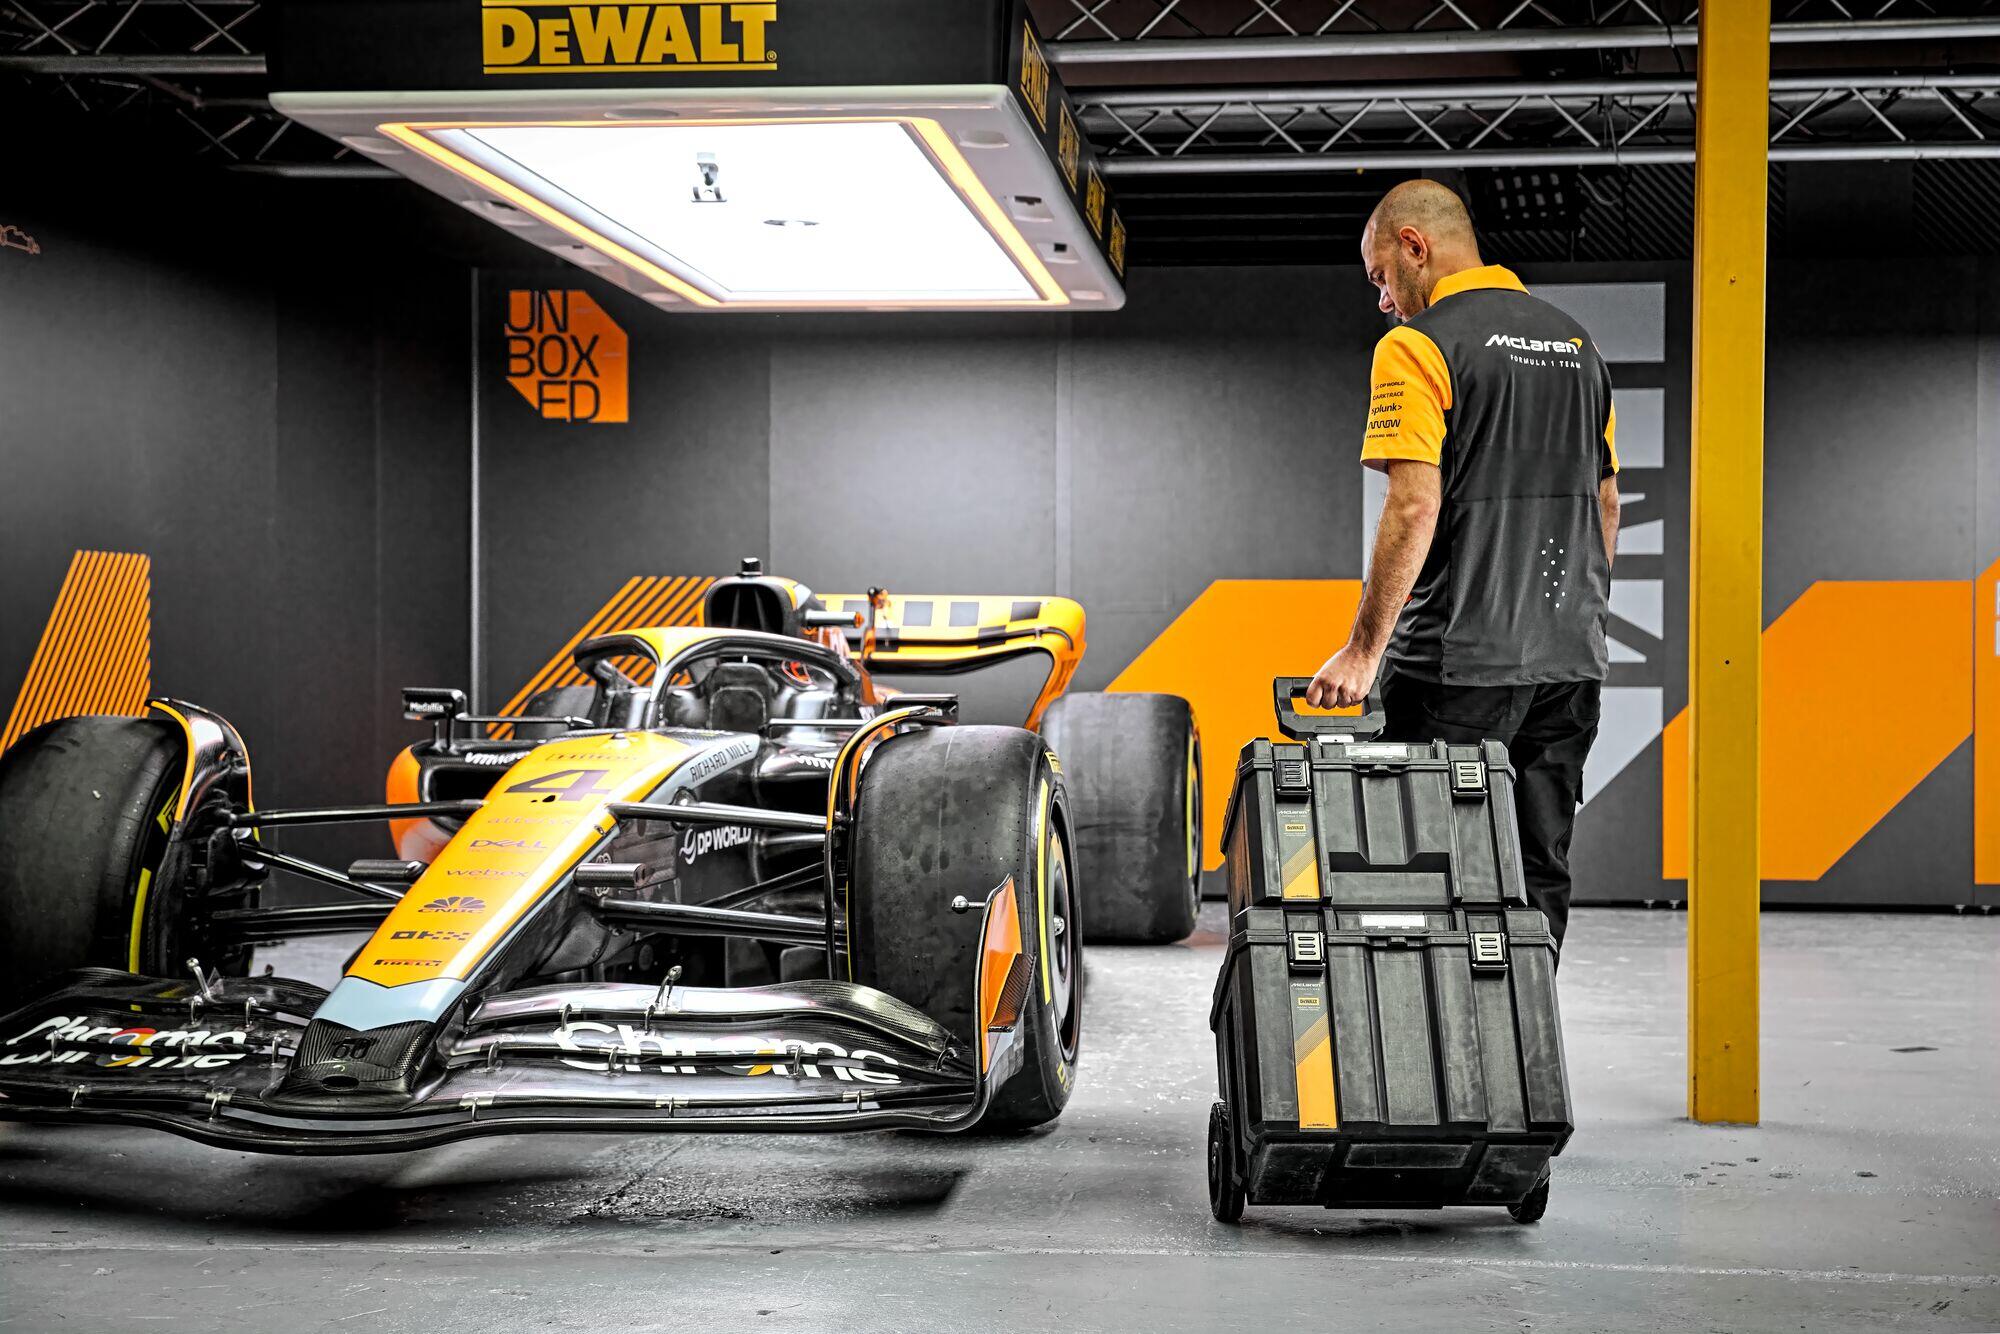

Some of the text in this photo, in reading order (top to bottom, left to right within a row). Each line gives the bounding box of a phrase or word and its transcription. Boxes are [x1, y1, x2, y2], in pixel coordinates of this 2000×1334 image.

[482, 5, 777, 65] DEWALT
[505, 289, 568, 333] UN
[505, 334, 600, 378] BOX
[1485, 334, 1582, 354] McLaren
[1510, 354, 1546, 366] FORMULA
[1560, 361, 1581, 369] TEAM
[538, 380, 601, 422] ED
[1373, 391, 1404, 400] DARKTRACE
[689, 741, 752, 782] RICHARD MILLE
[503, 770, 613, 801] 4
[712, 826, 752, 851] WORLD
